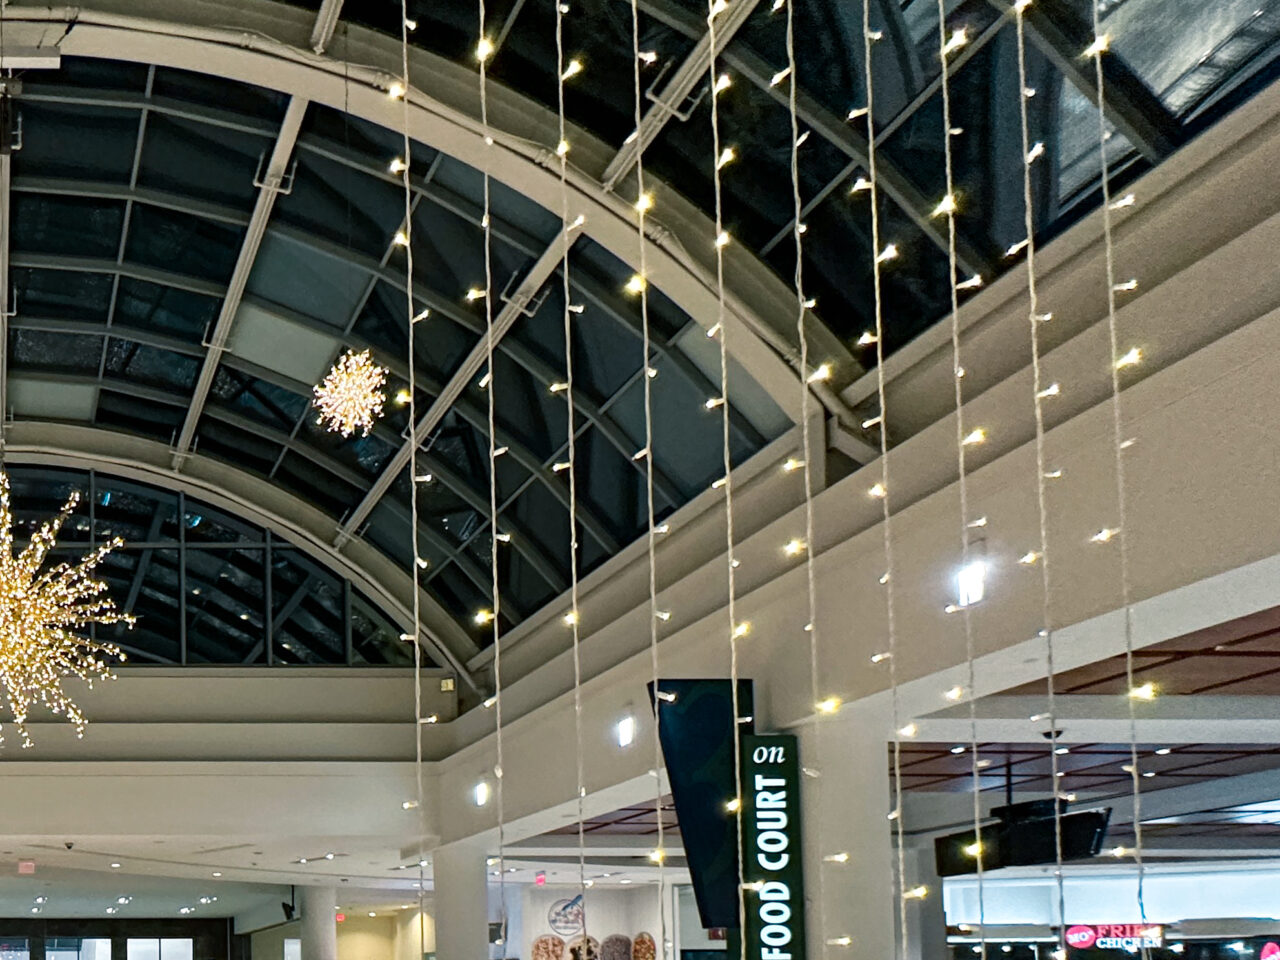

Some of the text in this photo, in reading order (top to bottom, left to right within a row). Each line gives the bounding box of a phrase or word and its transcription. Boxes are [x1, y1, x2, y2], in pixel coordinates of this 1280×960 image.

[753, 746, 786, 764] on
[755, 774, 792, 960] FOOD COURT
[1097, 924, 1160, 938] FRIE
